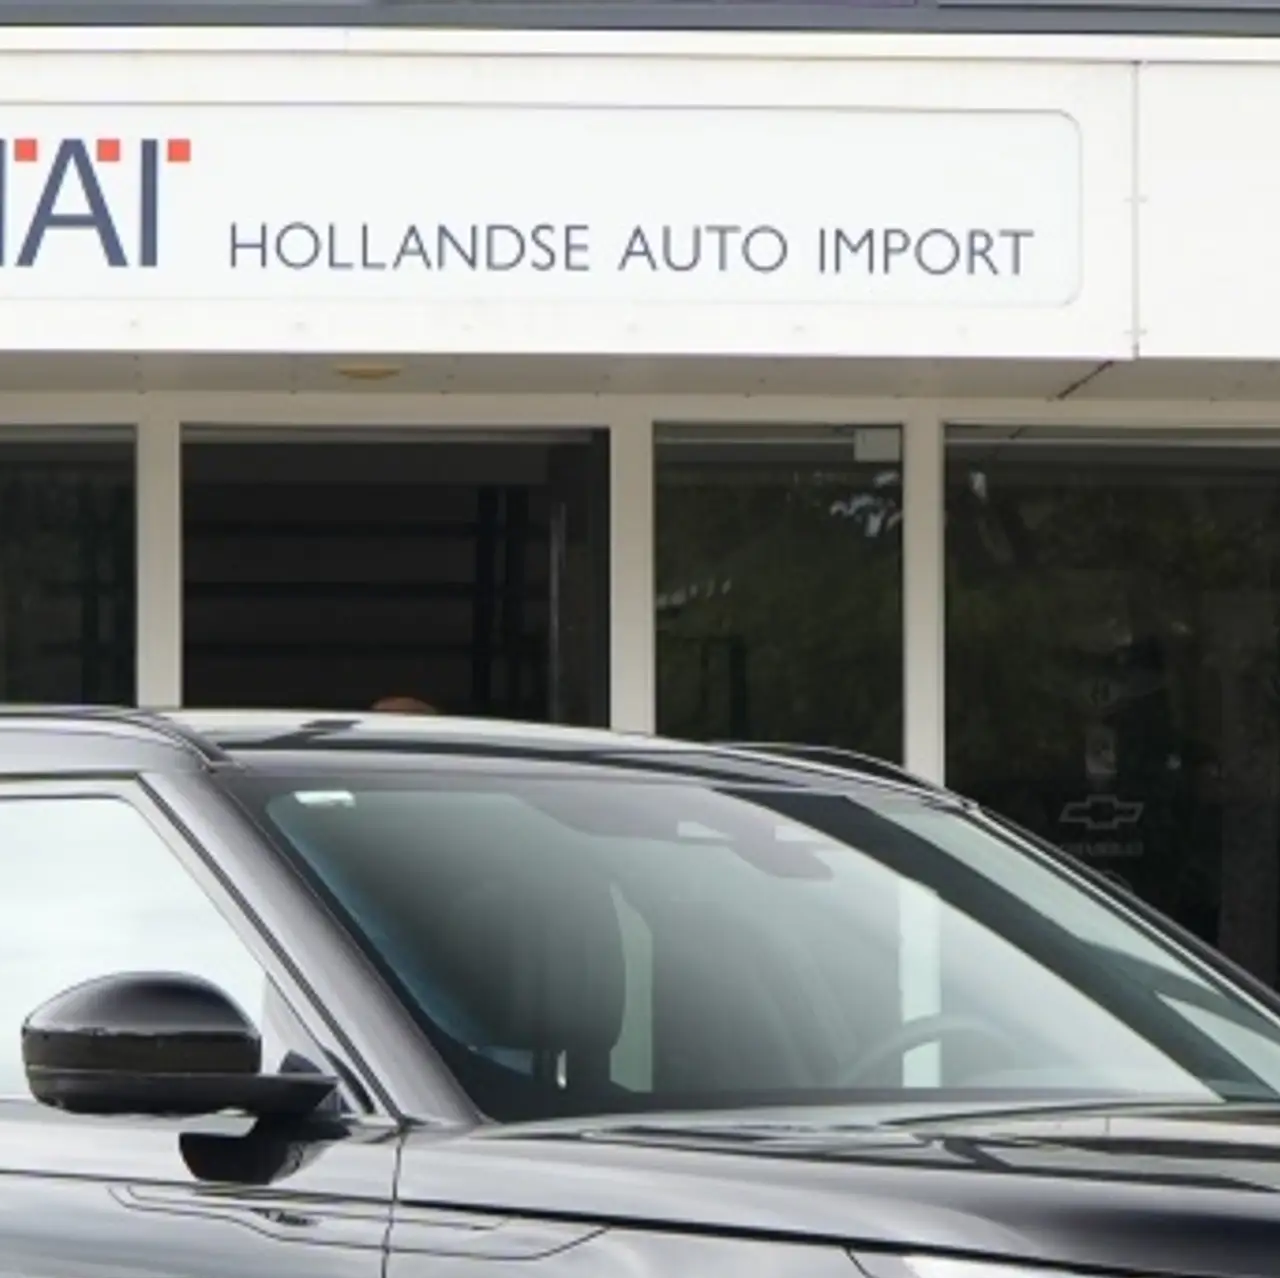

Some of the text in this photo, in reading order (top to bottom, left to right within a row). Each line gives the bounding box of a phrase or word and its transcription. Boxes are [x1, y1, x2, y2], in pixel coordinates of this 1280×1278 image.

[229, 222, 1034, 277] HOLLANDSE AUTO IMPORT
